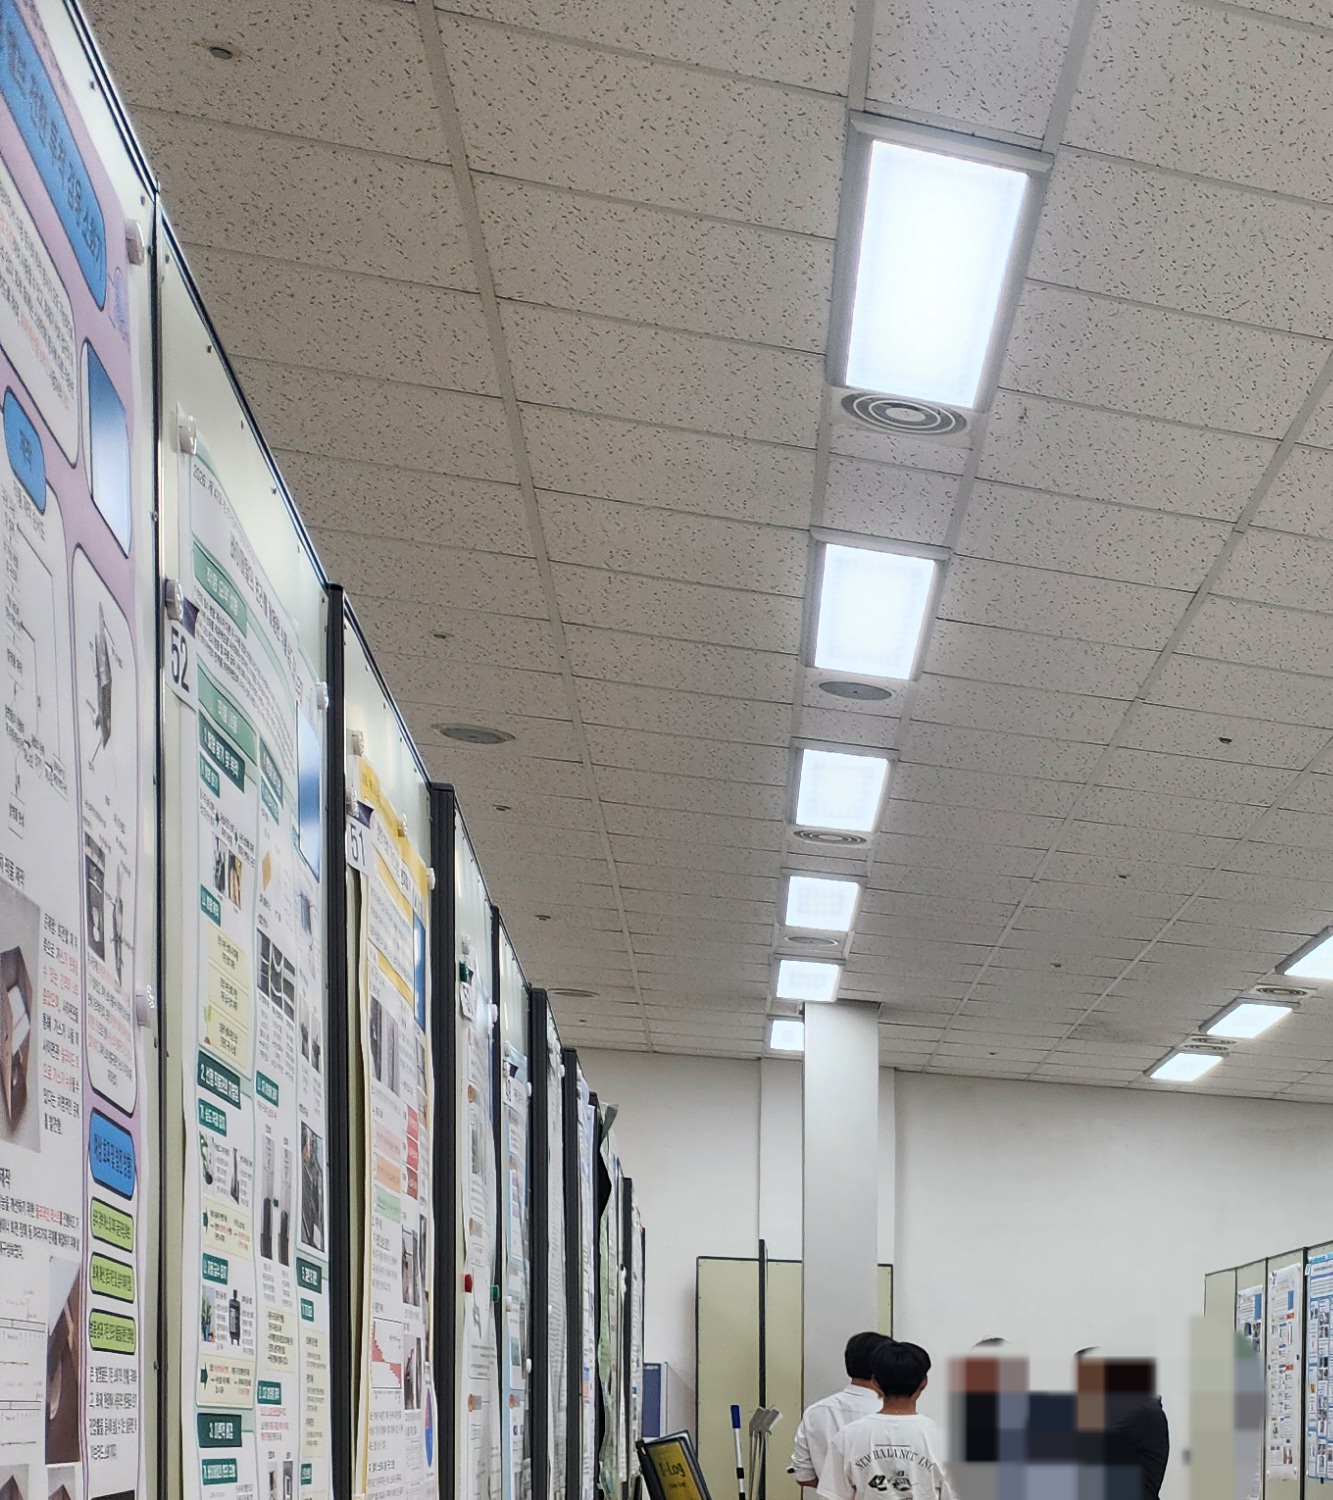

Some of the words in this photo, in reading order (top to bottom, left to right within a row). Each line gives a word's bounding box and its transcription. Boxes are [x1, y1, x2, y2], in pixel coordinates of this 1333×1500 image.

[171, 626, 190, 692] 52
[350, 822, 366, 866] 51
[855, 1454, 871, 1471] NEW
